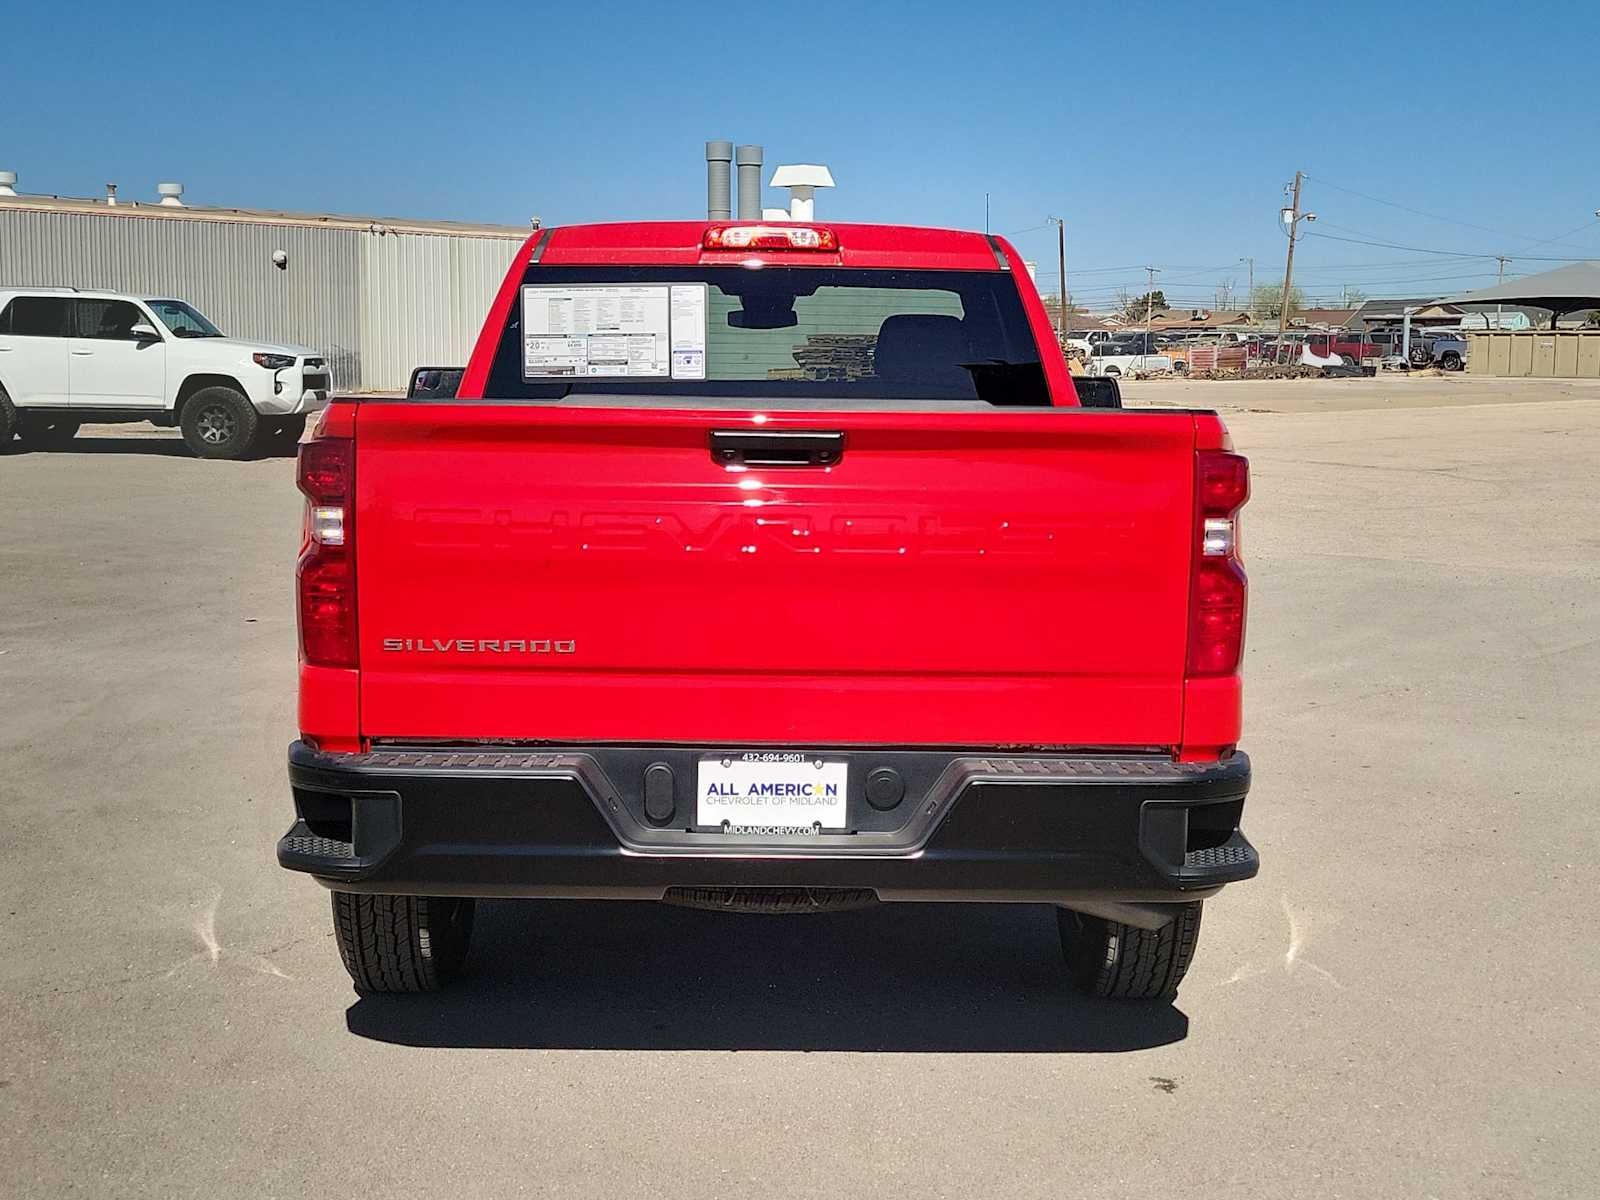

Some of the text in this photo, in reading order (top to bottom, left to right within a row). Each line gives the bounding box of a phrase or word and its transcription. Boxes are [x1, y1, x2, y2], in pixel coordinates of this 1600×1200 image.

[383, 638, 576, 653] SILVERADO
[742, 753, 805, 763] 432-694-9601
[707, 783, 838, 797] ALL AMERICN
[706, 796, 838, 806] CHEVROLET OF MIDLAND
[724, 825, 820, 836] MIDLANDCHEVY.COM
